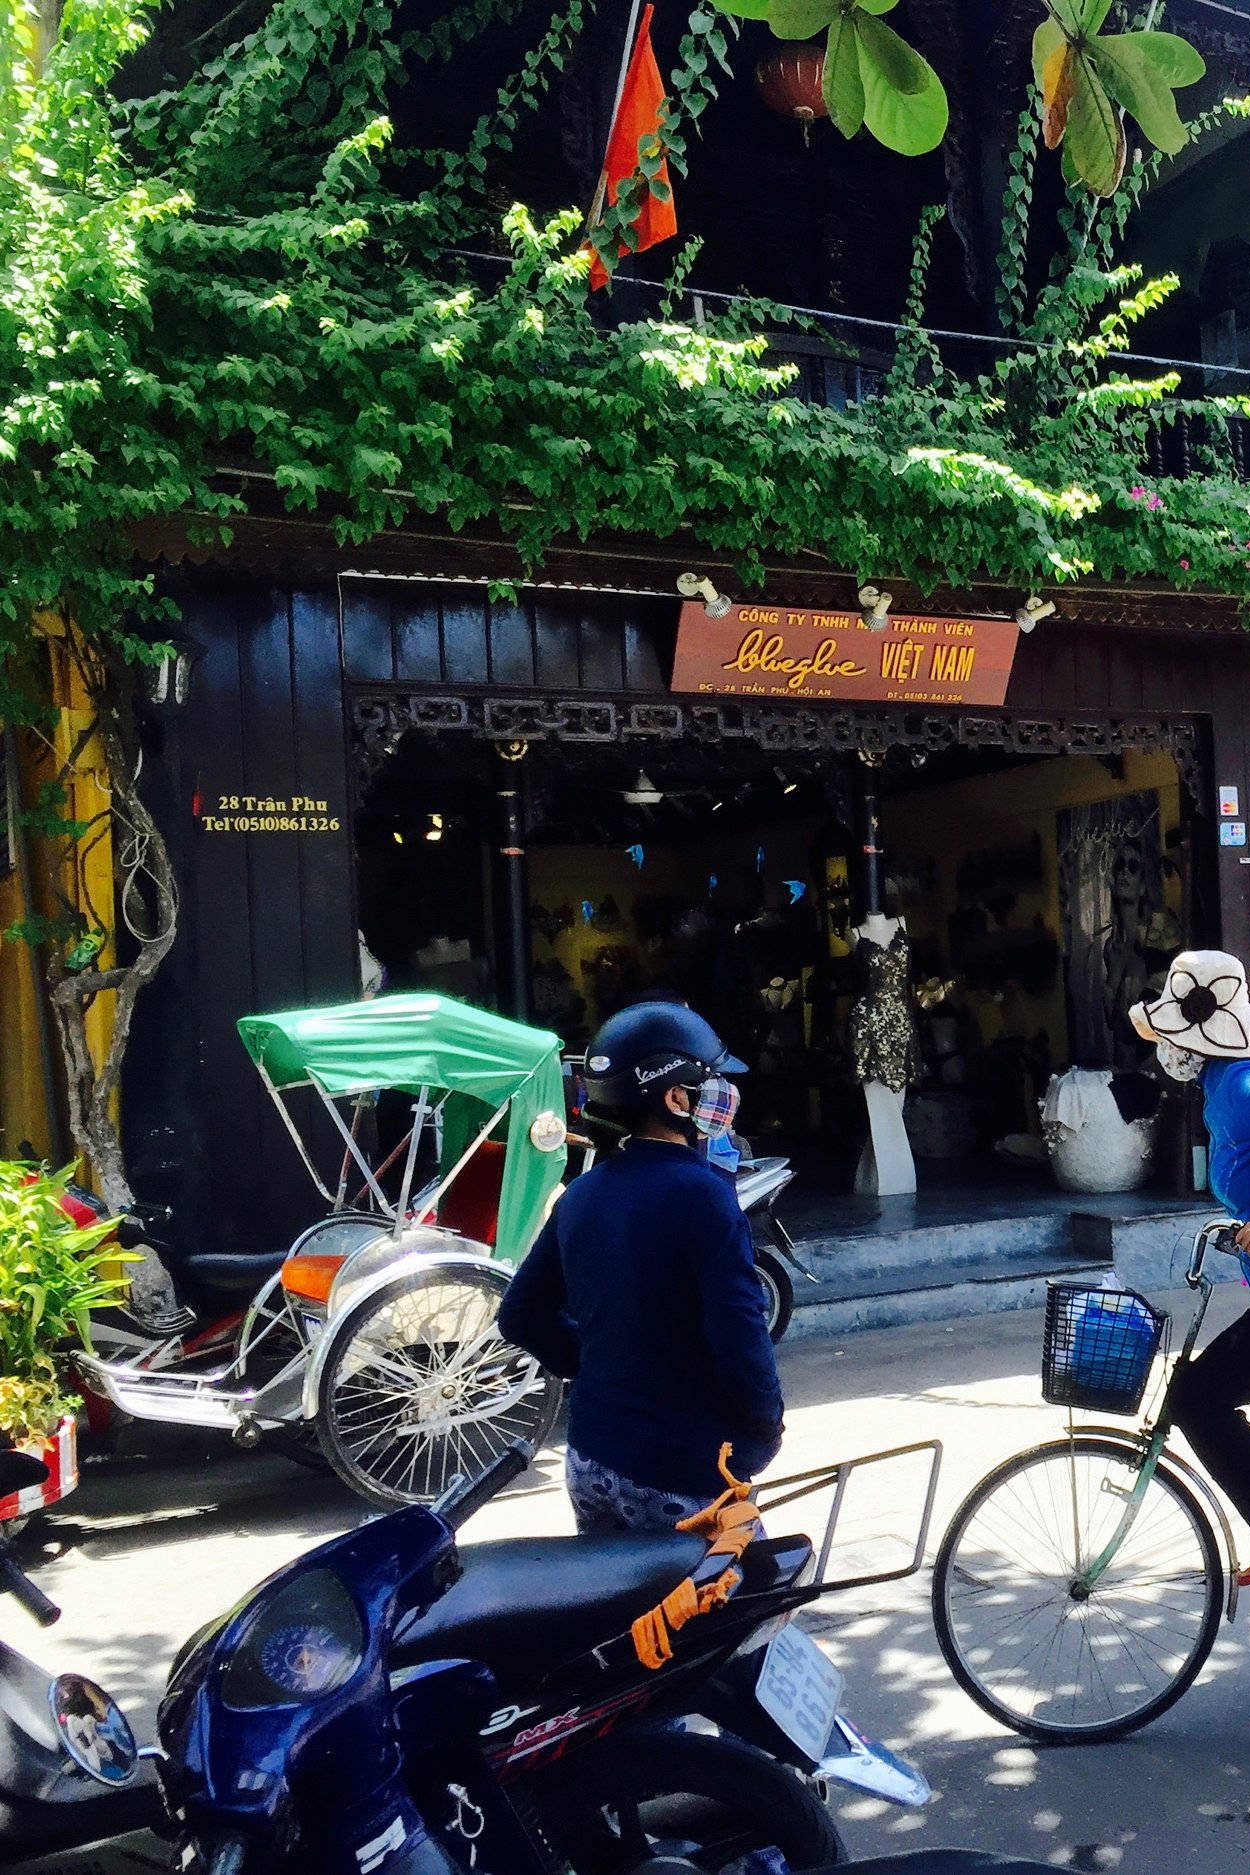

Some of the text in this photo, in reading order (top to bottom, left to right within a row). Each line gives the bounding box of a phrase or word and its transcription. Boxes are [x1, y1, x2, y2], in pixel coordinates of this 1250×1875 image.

[738, 609, 779, 625] CÔNG
[787, 613, 807, 625] TY
[812, 615, 850, 629] TNHH
[892, 619, 938, 634] THÀNH
[944, 622, 974, 636] VIÊN
[881, 638, 925, 683] VIỆT
[930, 645, 976, 682] NAM
[218, 796, 240, 810] 28
[635, 1058, 687, 1085] Vespa
